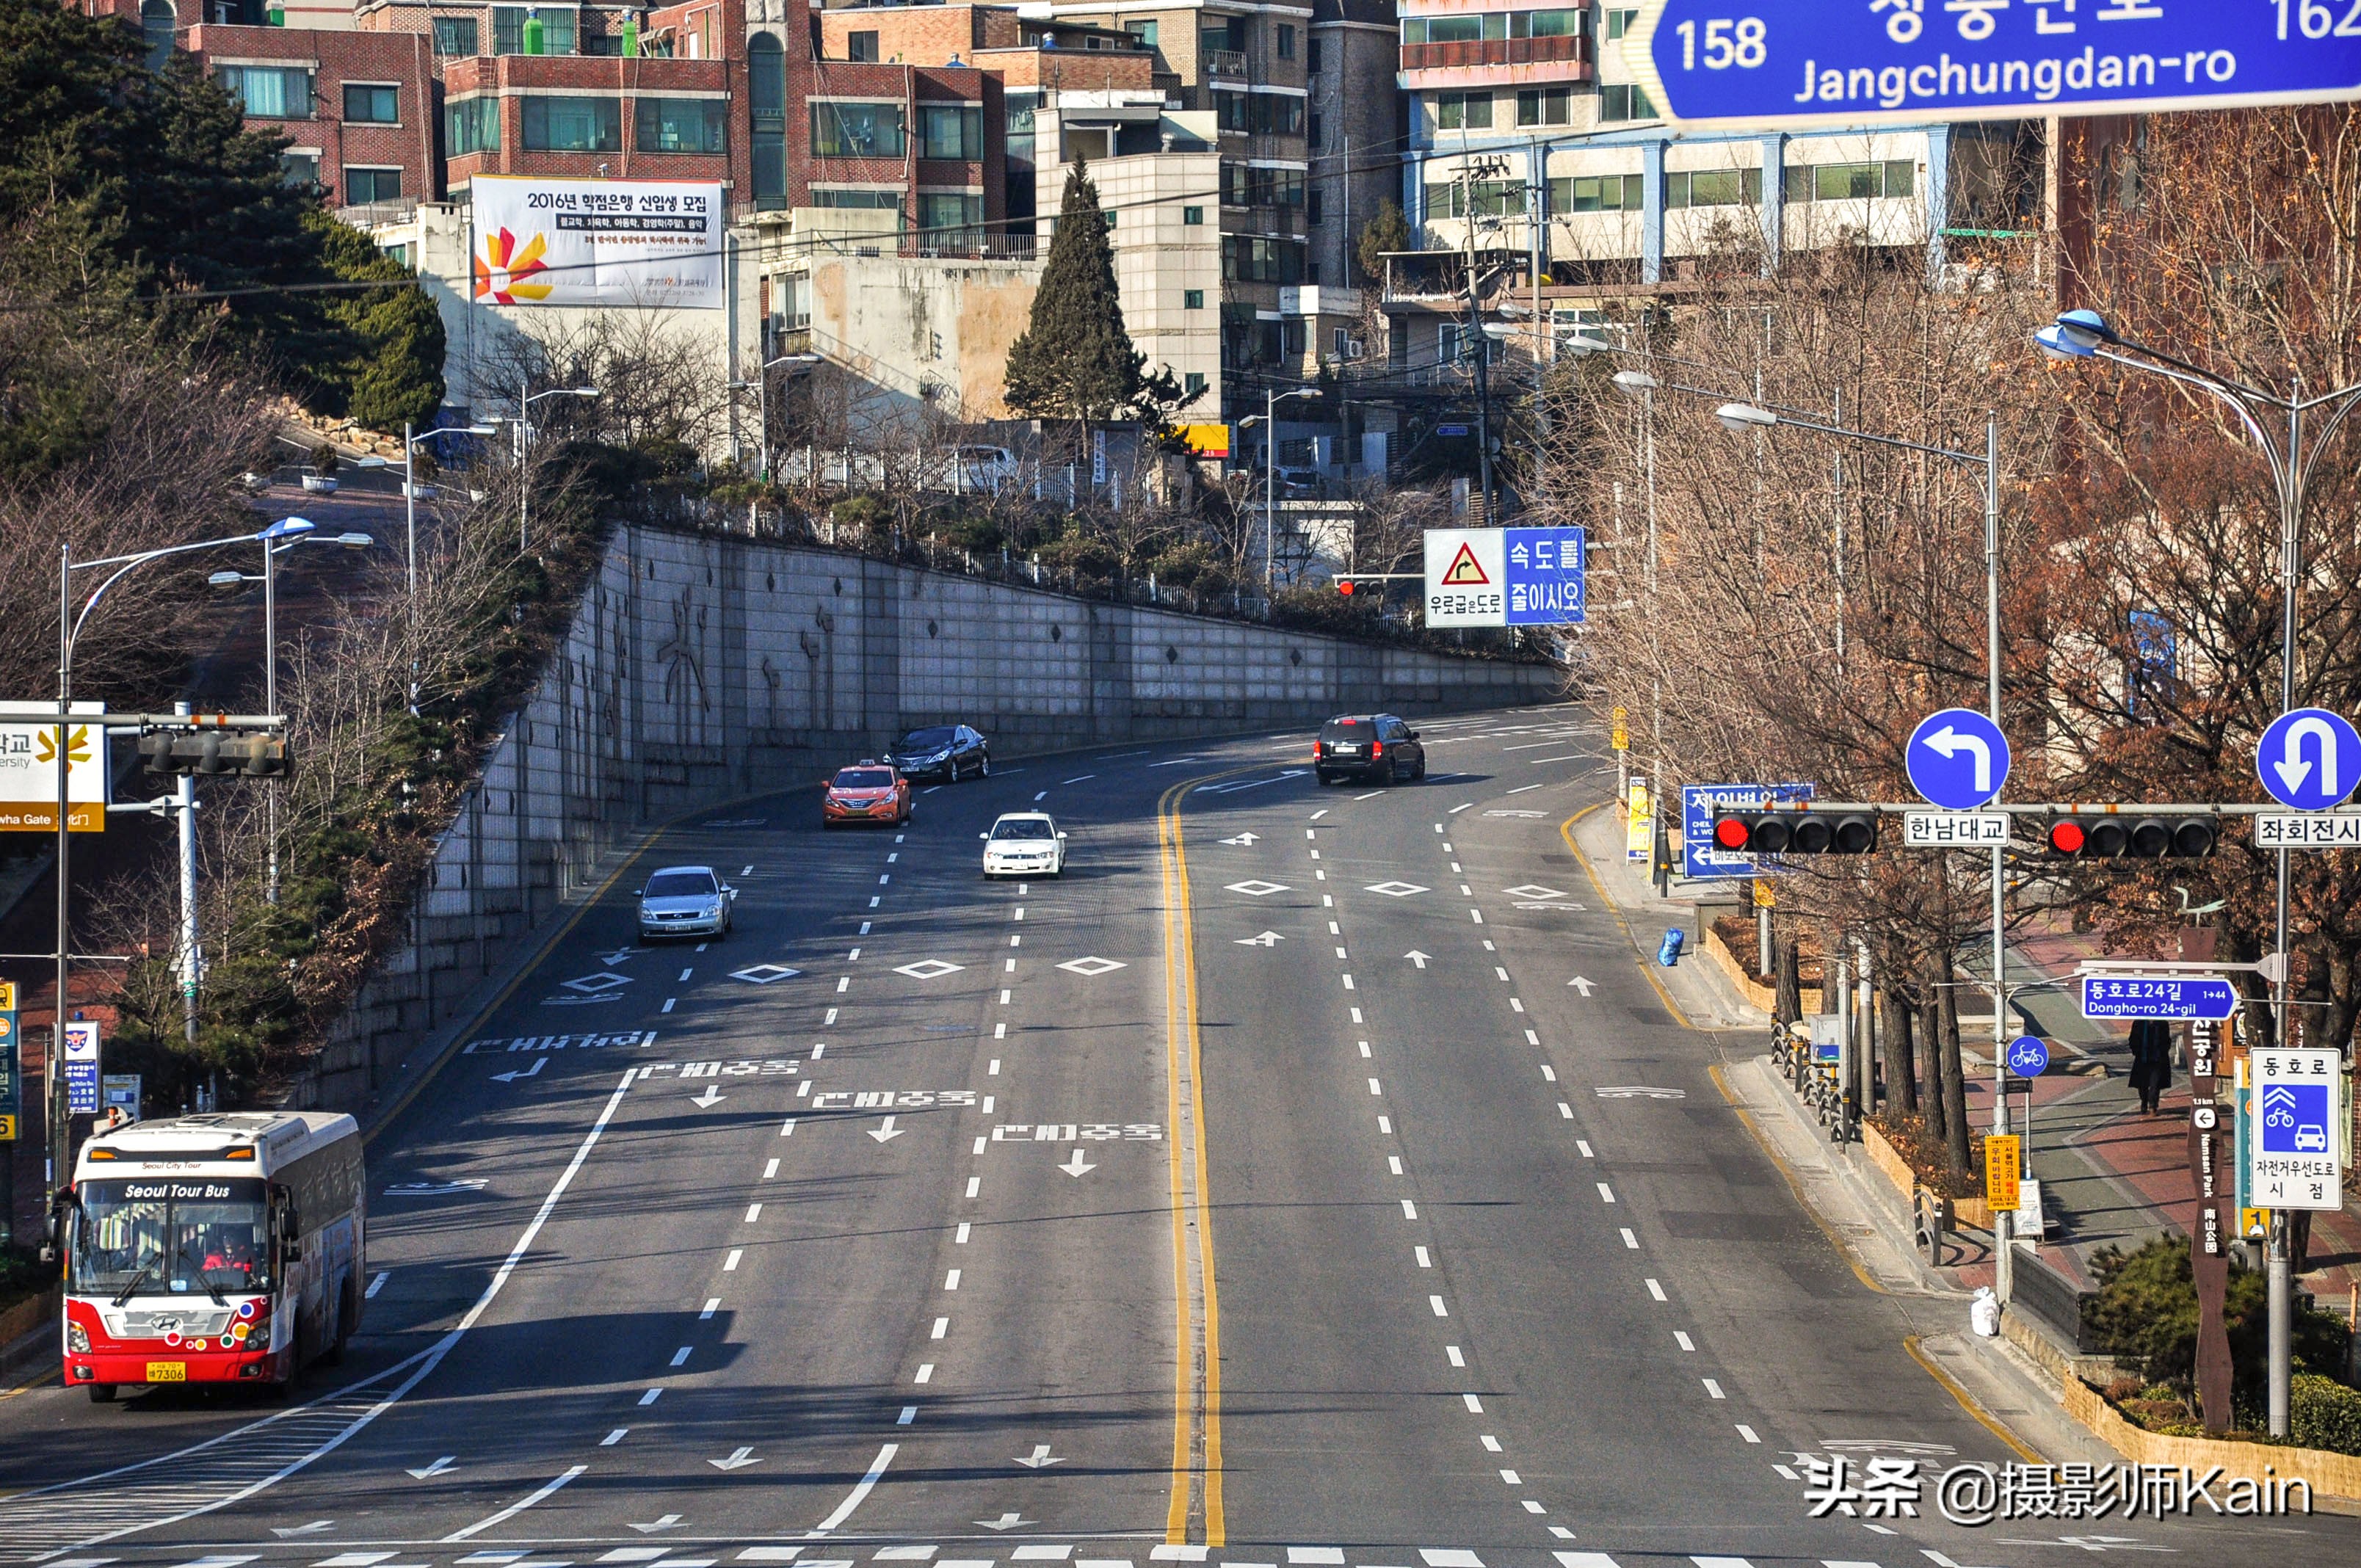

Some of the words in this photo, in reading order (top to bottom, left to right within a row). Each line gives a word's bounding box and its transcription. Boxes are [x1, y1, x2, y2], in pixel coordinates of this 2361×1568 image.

[1676, 16, 1767, 70] 158
[1794, 46, 2236, 108] Jangchungdan-ro
[528, 192, 577, 210] 2016년
[582, 194, 633, 211] 학점은행
[639, 195, 677, 212] 신입생
[683, 196, 706, 212] 모집
[1511, 540, 1578, 570] 속도를
[1431, 595, 1501, 614] 우로굽은도로
[1512, 582, 1579, 611] 줄이시오
[23, 814, 51, 825] Gate
[1910, 818, 2004, 841] 한남대교
[2262, 819, 2359, 842] 좌회전시
[2089, 981, 2182, 1001] 동호로24길
[2089, 1002, 2157, 1015] Dongho-ro
[2161, 1003, 2196, 1016] 24-gil
[2263, 1057, 2327, 1076] 동호로
[813, 1090, 976, 1108] 동호대교
[993, 1124, 1162, 1141] 동호대교
[2201, 1133, 2211, 1174] Namsan
[167, 1162, 182, 1170] City
[2257, 1159, 2335, 1177] 자전거우선도로
[126, 1185, 167, 1198] Seoul
[170, 1184, 203, 1197] Tour
[204, 1185, 230, 1198] Bus
[2203, 1175, 2213, 1198] Park
